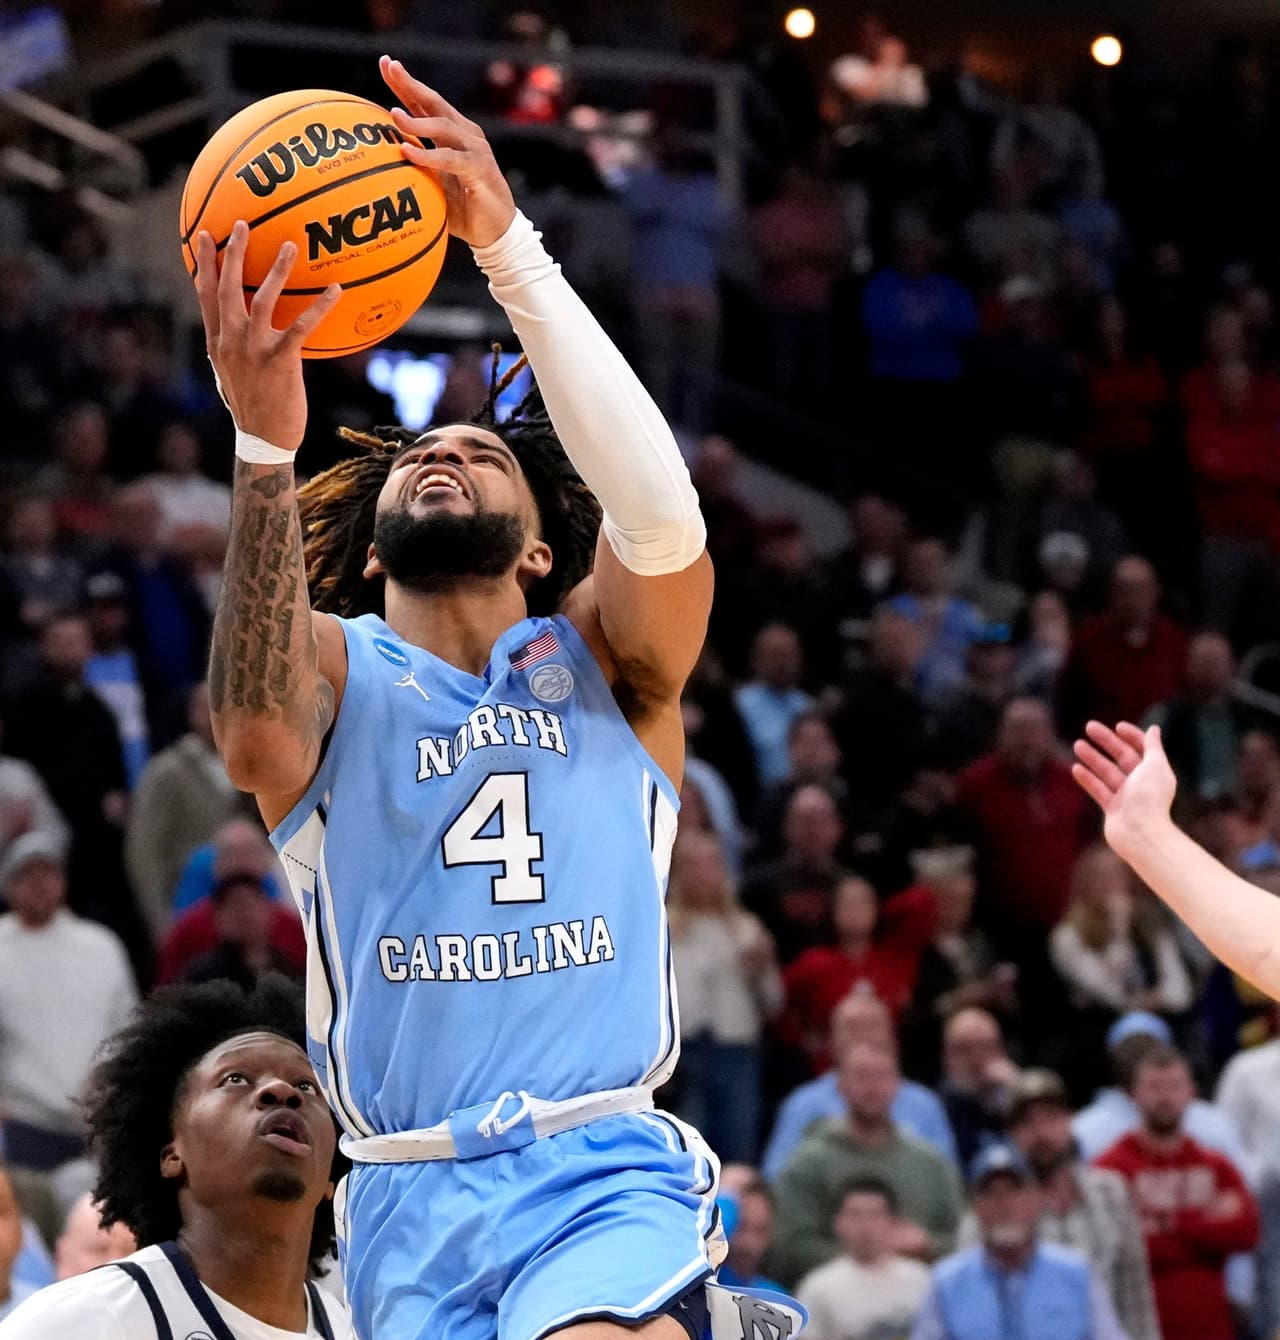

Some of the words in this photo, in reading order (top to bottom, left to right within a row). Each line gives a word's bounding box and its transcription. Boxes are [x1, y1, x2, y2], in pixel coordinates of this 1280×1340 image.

[235, 122, 404, 198] Wilson
[305, 186, 422, 261] NCAA
[310, 252, 361, 272] OFFICIAL
[366, 238, 398, 253] GAME
[400, 227, 423, 241] BALL
[416, 703, 568, 783] NORTH
[441, 771, 546, 905] 4
[377, 915, 615, 982] CAROLINA
